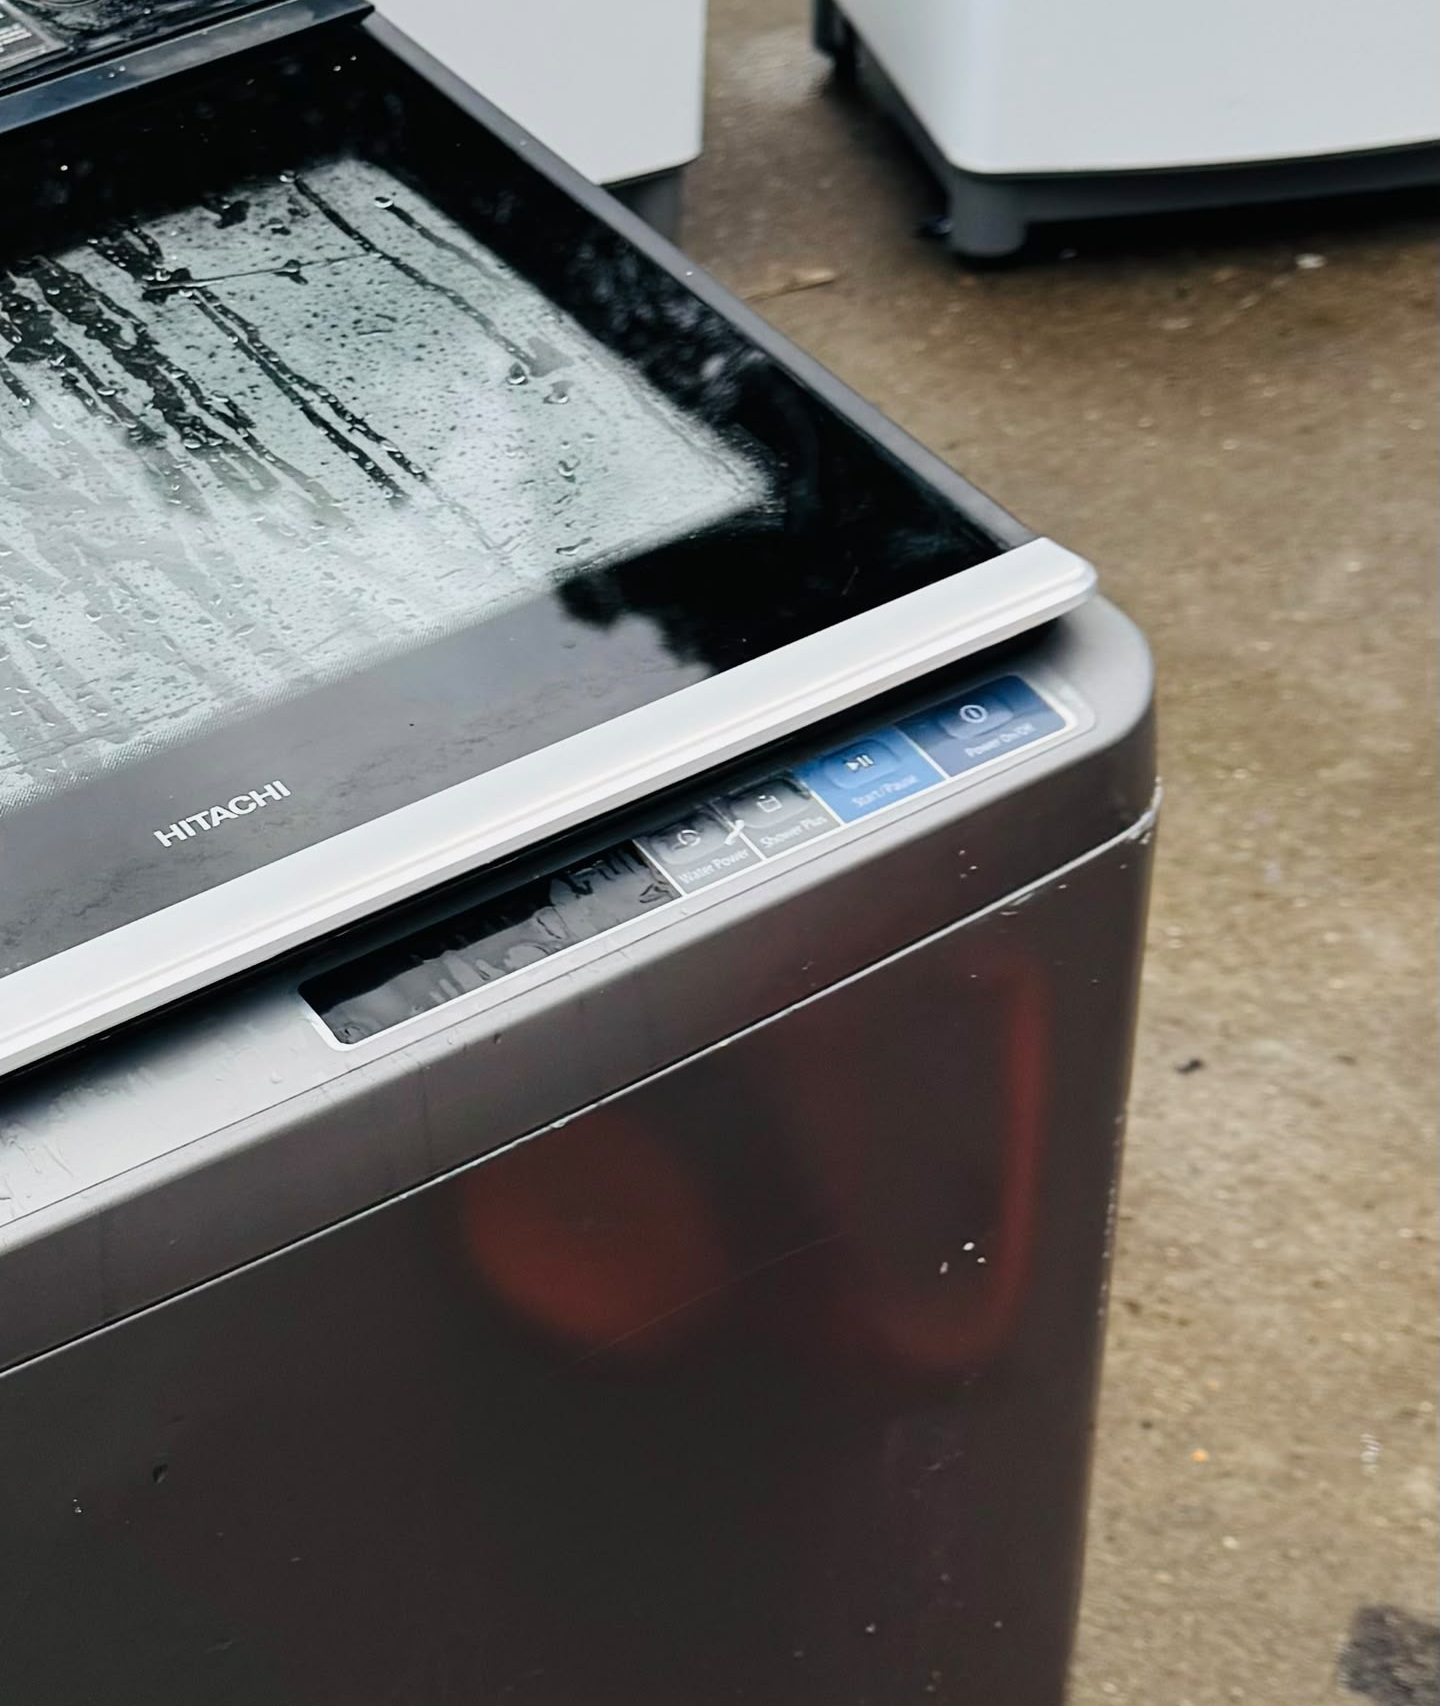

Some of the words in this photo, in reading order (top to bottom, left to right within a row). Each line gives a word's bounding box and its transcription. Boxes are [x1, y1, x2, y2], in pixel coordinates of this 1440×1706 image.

[964, 738, 1001, 758] Power
[153, 780, 292, 847] HITACHI
[760, 824, 803, 849] Shower
[800, 815, 829, 831] Plus
[678, 860, 715, 885] Water
[713, 848, 751, 872] Power
